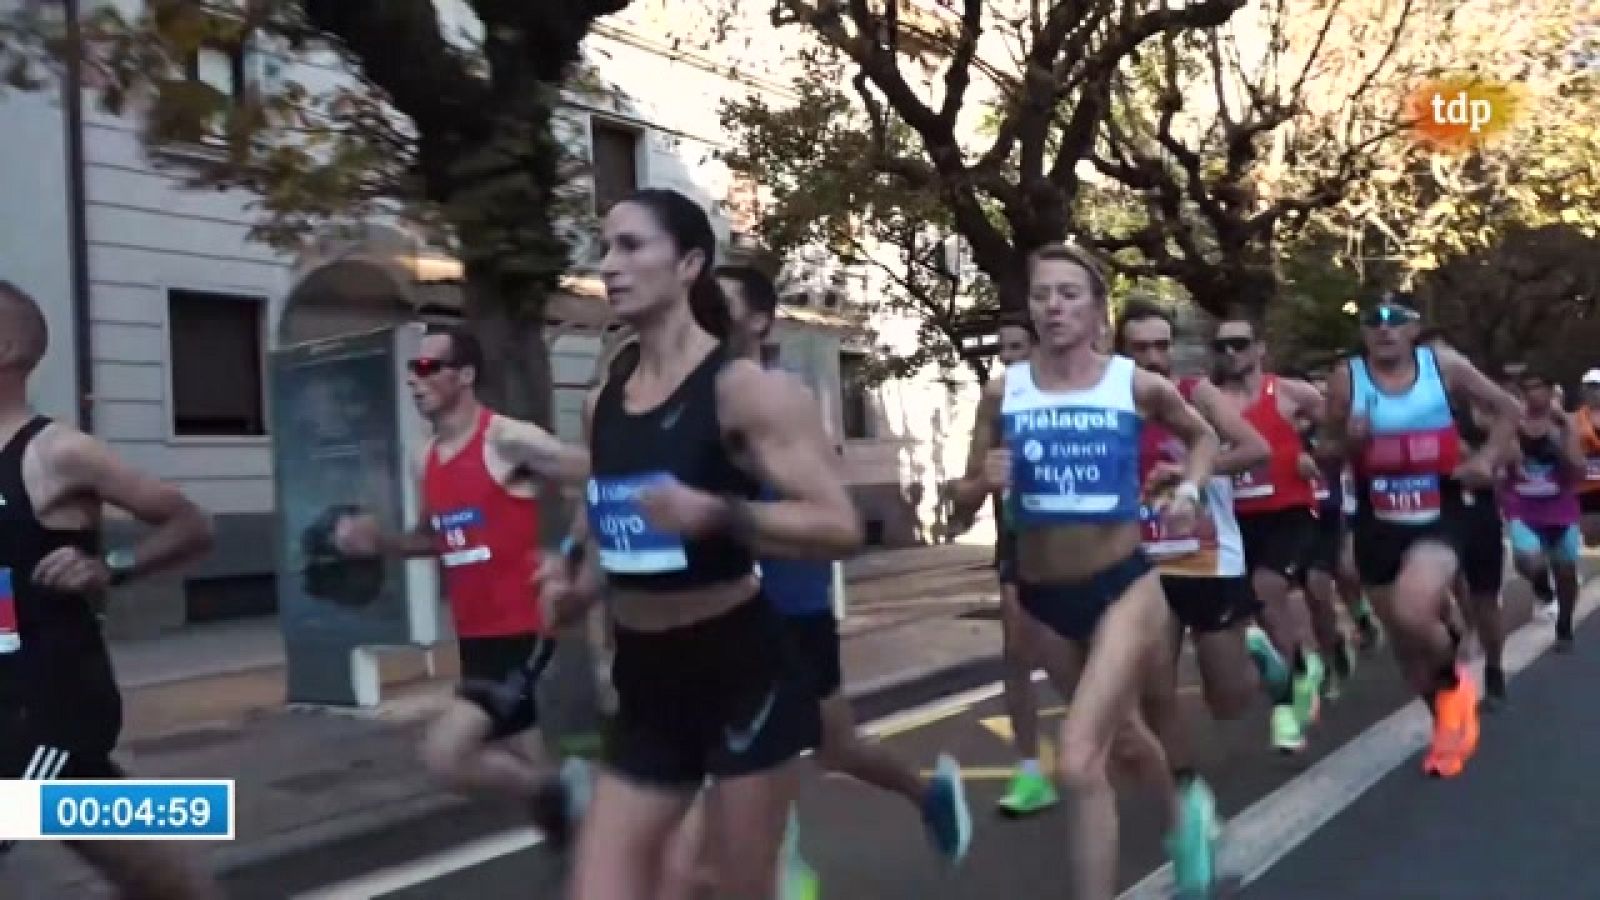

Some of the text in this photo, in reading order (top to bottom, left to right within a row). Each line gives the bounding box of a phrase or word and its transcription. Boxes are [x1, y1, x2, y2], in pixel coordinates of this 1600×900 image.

[1051, 441, 1107, 457] ZURICH
[1034, 465, 1100, 482] PELAYO
[1389, 491, 1421, 510] 101
